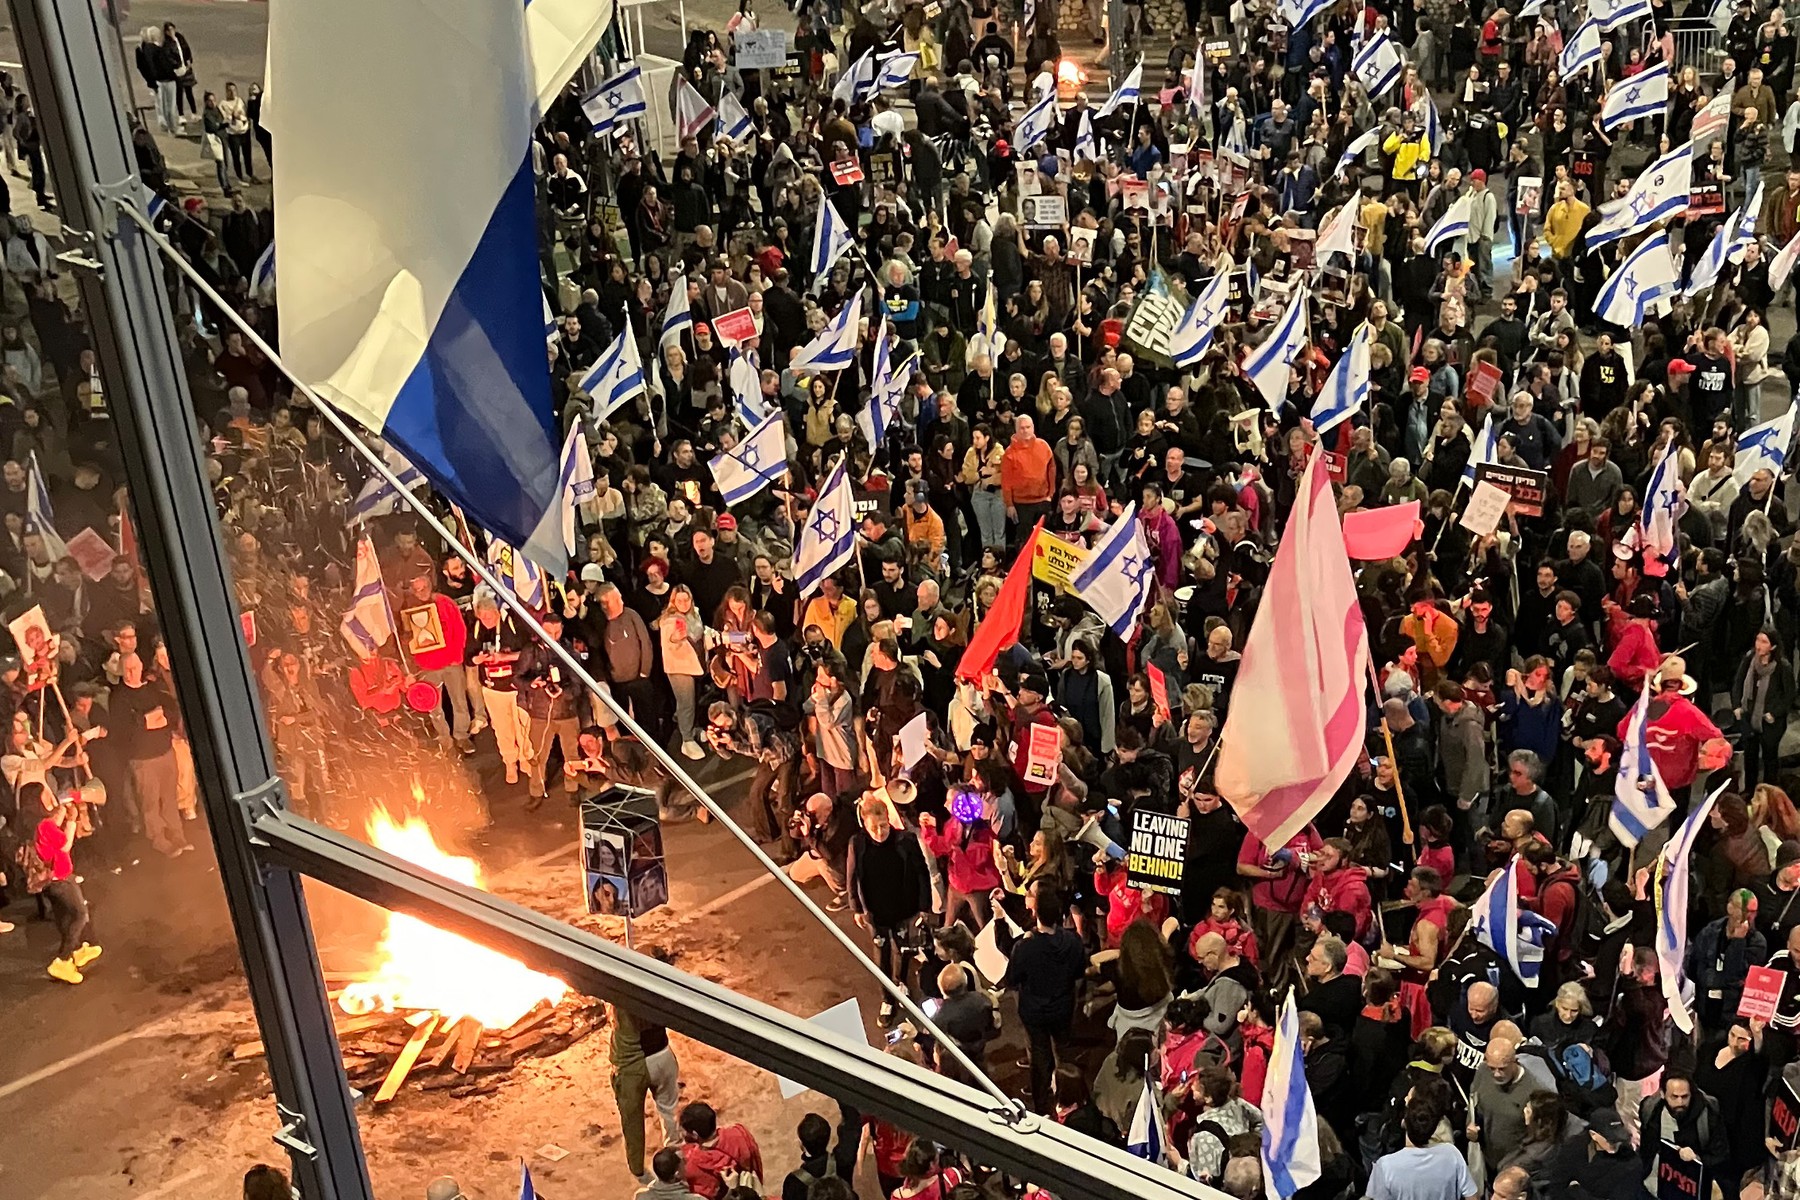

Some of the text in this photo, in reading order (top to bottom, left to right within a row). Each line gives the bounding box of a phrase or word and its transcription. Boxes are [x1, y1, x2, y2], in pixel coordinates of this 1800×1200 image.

[1573, 161, 1593, 174] SOS
[1126, 285, 1169, 346] אחים
[1133, 812, 1188, 839] LEAVING
[1131, 830, 1187, 861] NO ONE
[1129, 853, 1184, 880] BEHIND!
